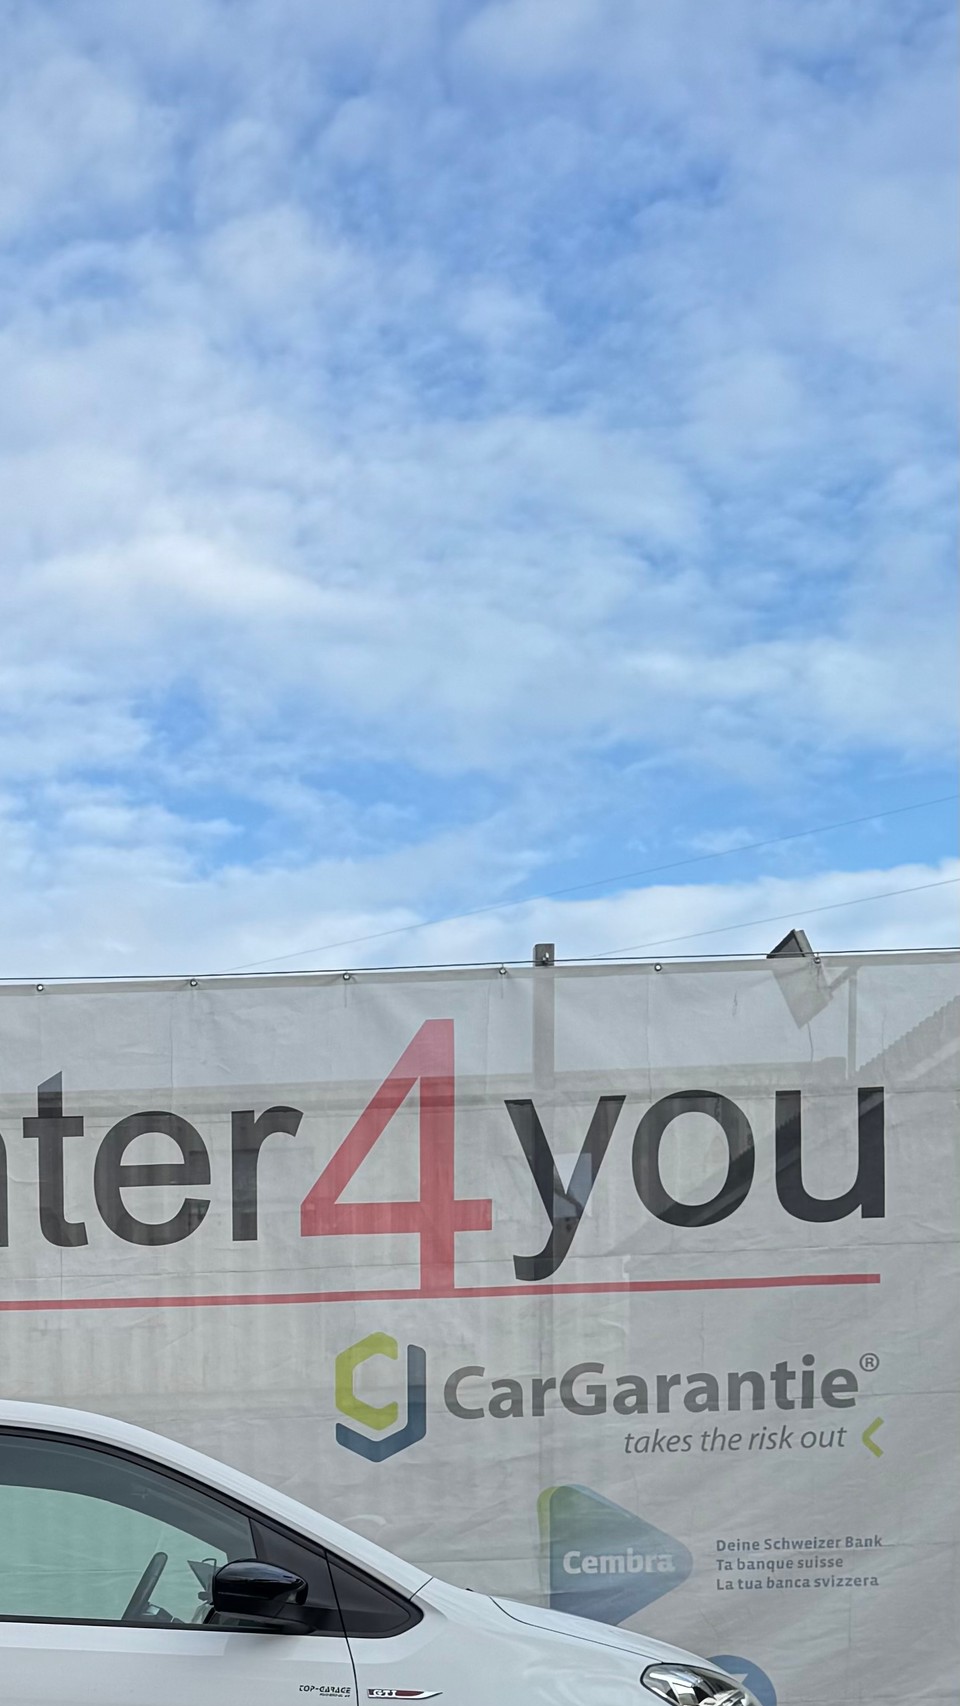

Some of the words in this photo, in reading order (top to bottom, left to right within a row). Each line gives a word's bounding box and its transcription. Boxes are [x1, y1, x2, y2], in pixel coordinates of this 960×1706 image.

[624, 1428, 693, 1454] takes
[700, 1427, 742, 1452] the
[748, 1425, 794, 1450] risk
[800, 1426, 847, 1449] out
[716, 1538, 760, 1552] Deine
[763, 1536, 842, 1551] Schweizer
[845, 1534, 883, 1549] Bank
[562, 1547, 677, 1575] Cembra
[716, 1558, 733, 1571] Ta
[737, 1557, 794, 1573] banque
[797, 1555, 844, 1569] suisse
[716, 1578, 734, 1591] La
[738, 1577, 763, 1590] tua
[766, 1576, 811, 1590] banca
[814, 1574, 880, 1588] svizzera
[299, 1684, 351, 1694] TOP-GARAGE
[373, 1688, 398, 1698] GTI
